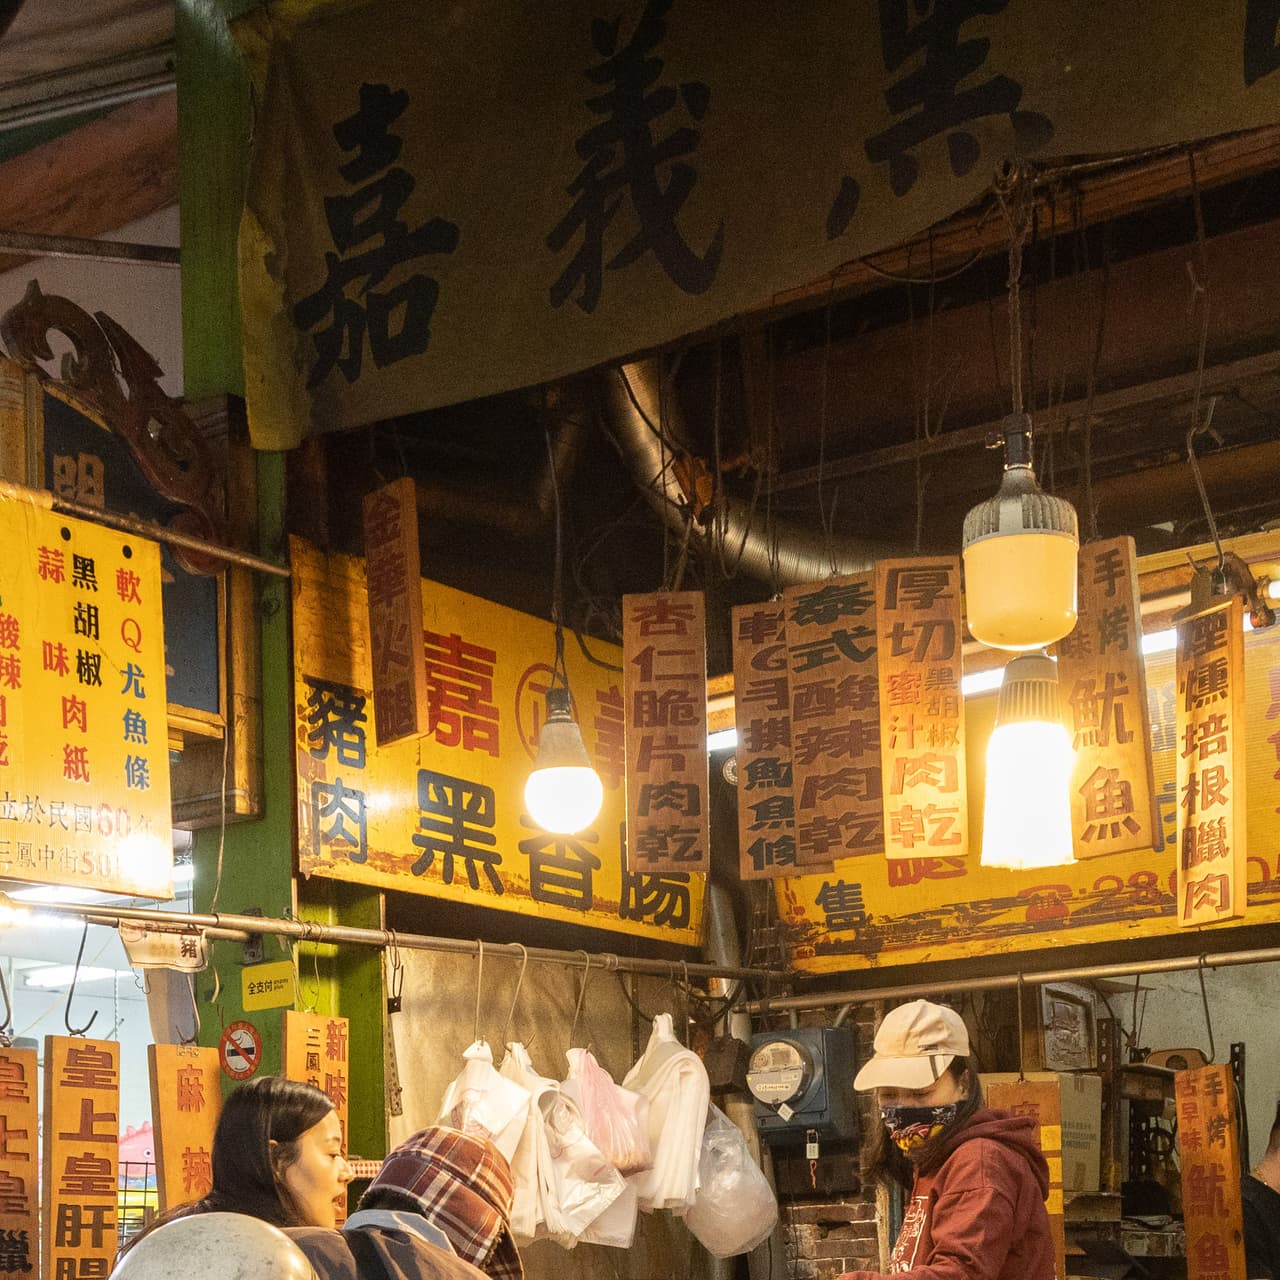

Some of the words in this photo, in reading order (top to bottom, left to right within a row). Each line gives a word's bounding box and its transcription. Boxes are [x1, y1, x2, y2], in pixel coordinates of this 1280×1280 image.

[37, 546, 71, 679] 蒜味
[71, 552, 104, 690] 黑胡椒
[115, 567, 151, 793] 軟Q尤魚條
[885, 563, 956, 664] 厚切
[60, 694, 91, 785] 肉紙
[303, 674, 369, 865] 豬肉
[630, 600, 704, 864] 杏仁脆片肉乾
[788, 580, 886, 856] 泰式酸辣肉乾
[886, 670, 923, 750] 蜜汁
[924, 667, 960, 748] 黑胡椒
[1067, 672, 1142, 845] 魷魚
[1180, 610, 1232, 921] 煙燻培根臘肉
[410, 768, 692, 931] 黑香腸
[888, 752, 963, 850] 肉乾
[247, 976, 274, 996] 全支付
[1176, 1073, 1204, 1153] 古早味
